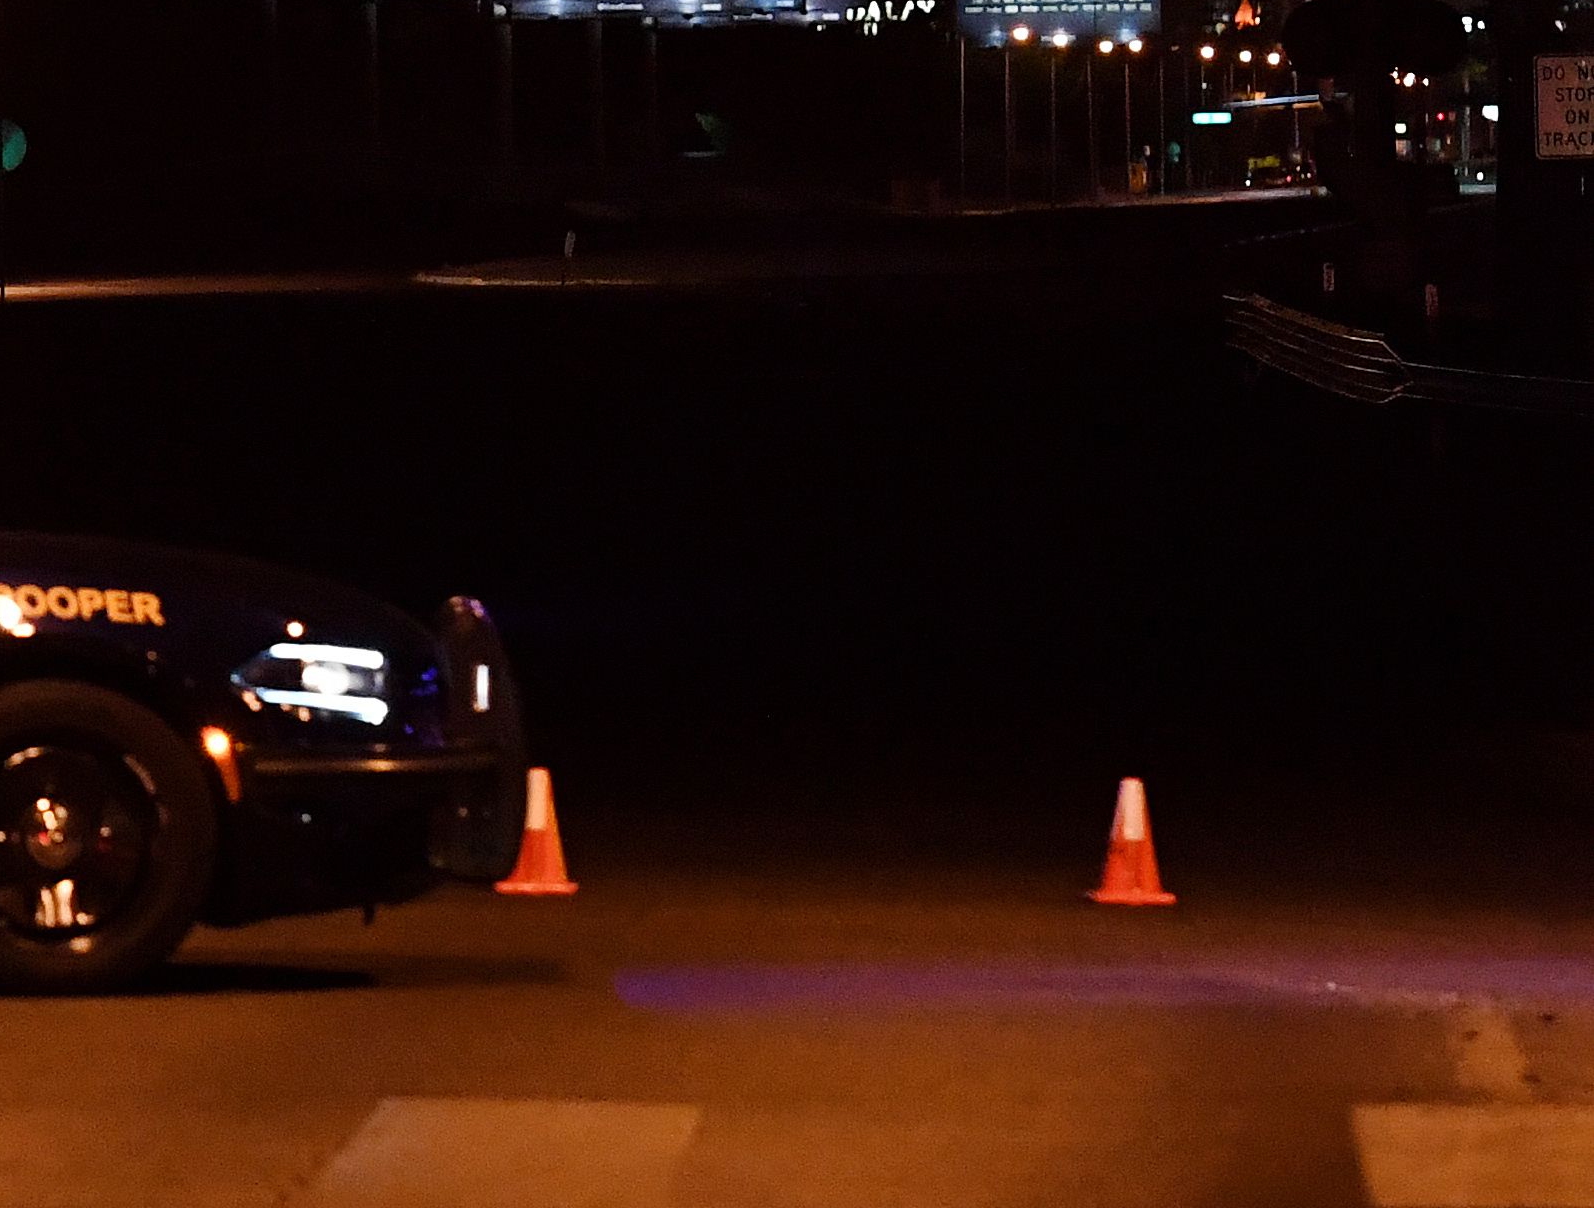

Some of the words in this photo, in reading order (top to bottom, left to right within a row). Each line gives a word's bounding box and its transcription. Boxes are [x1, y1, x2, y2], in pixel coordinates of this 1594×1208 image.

[1542, 65, 1565, 81] DO
[1566, 109, 1590, 125] ON
[1543, 131, 1594, 149] TRAC
